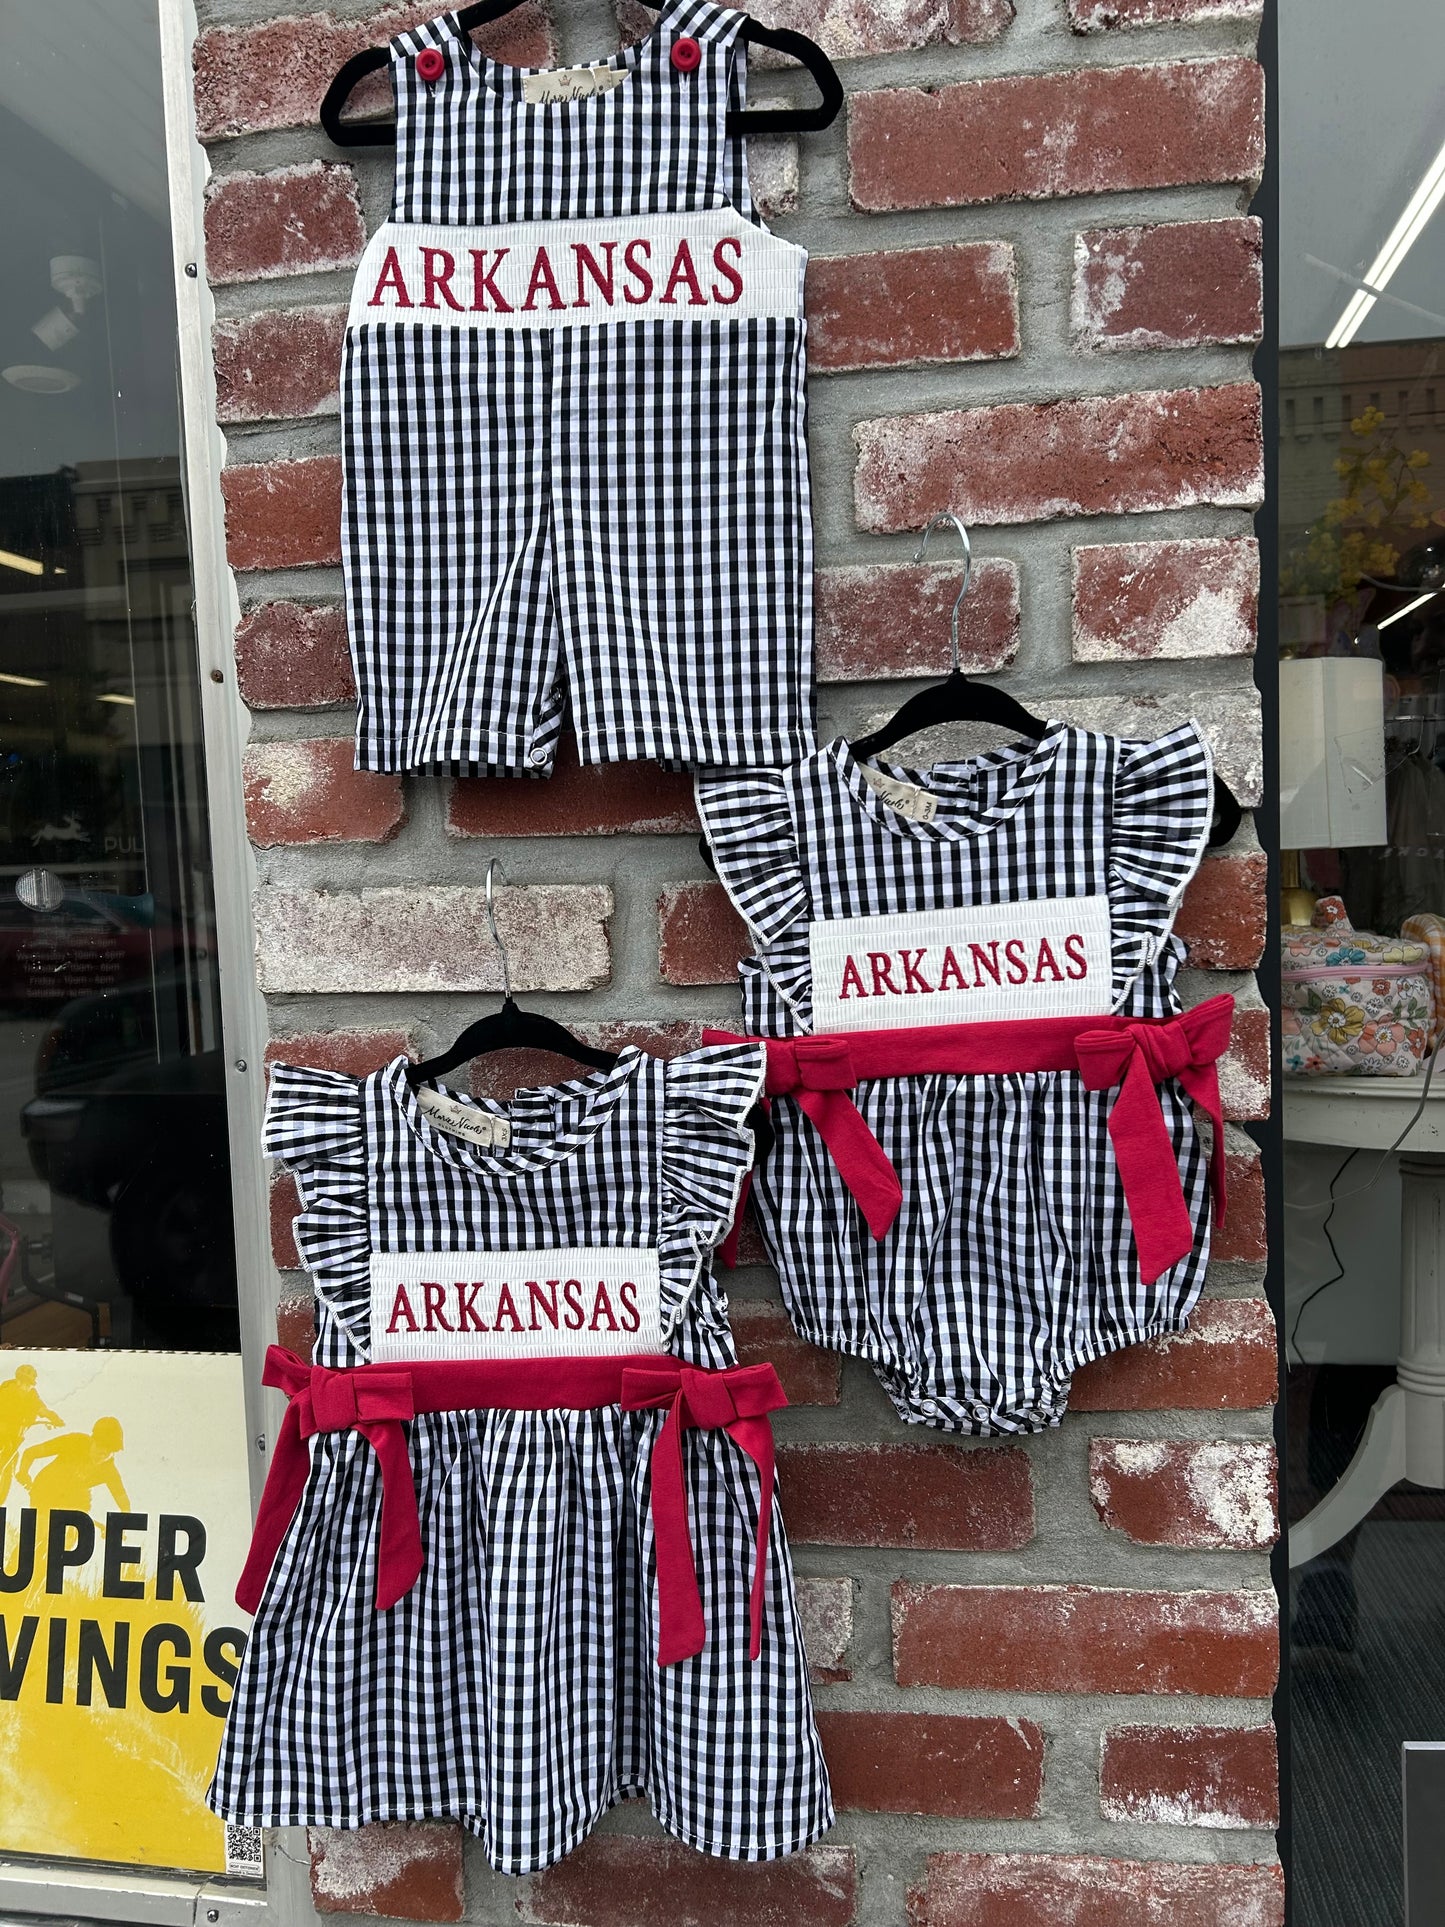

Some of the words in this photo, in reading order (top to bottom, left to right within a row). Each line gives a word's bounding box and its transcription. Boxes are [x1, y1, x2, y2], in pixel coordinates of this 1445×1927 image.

[367, 237, 743, 313] ARKANSAS
[839, 934, 1087, 999] ARKANSAS
[385, 1280, 640, 1333] ARKANSAS
[0, 1507, 207, 1602] UPER
[0, 1614, 247, 1718] VINGS
